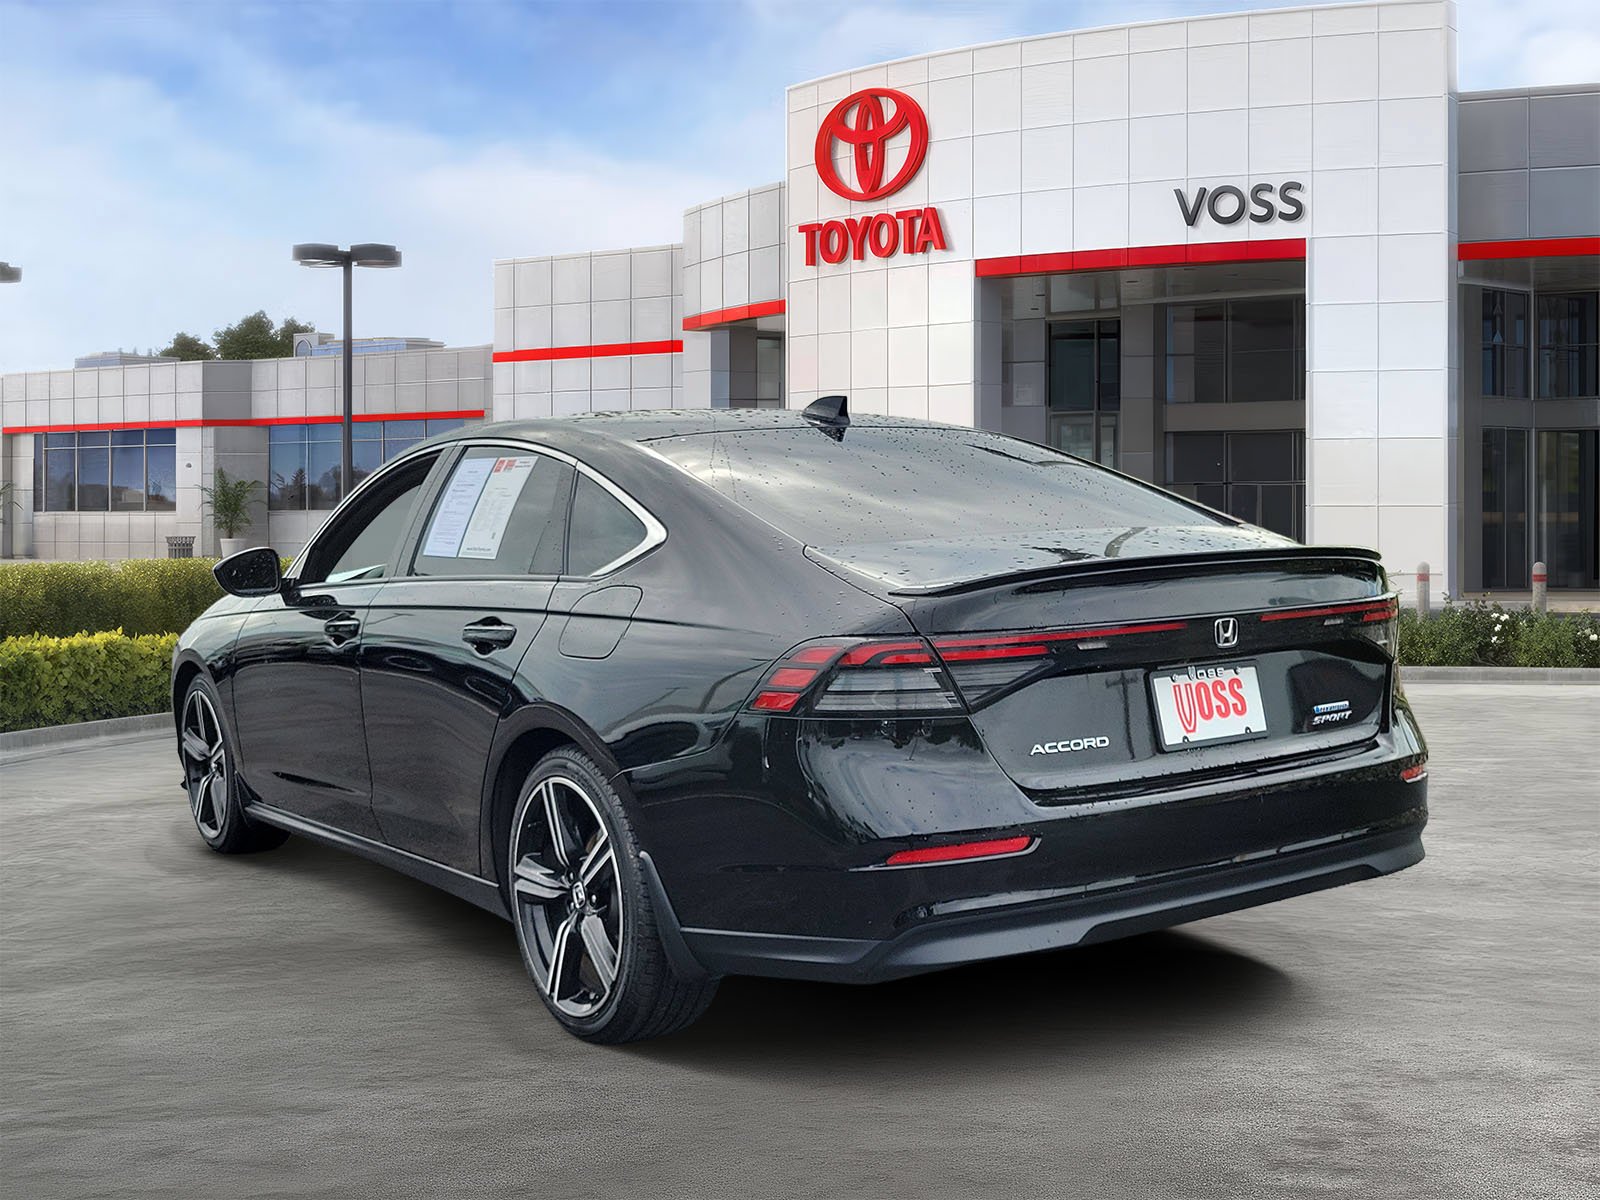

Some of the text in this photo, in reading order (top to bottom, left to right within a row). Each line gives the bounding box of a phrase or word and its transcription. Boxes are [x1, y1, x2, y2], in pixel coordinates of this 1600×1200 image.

[1173, 181, 1306, 226] VOSS
[798, 206, 948, 267] TOYOTA
[1172, 677, 1248, 734] VOSS
[1312, 710, 1352, 725] SPORT
[1029, 736, 1110, 756] ACCORD
